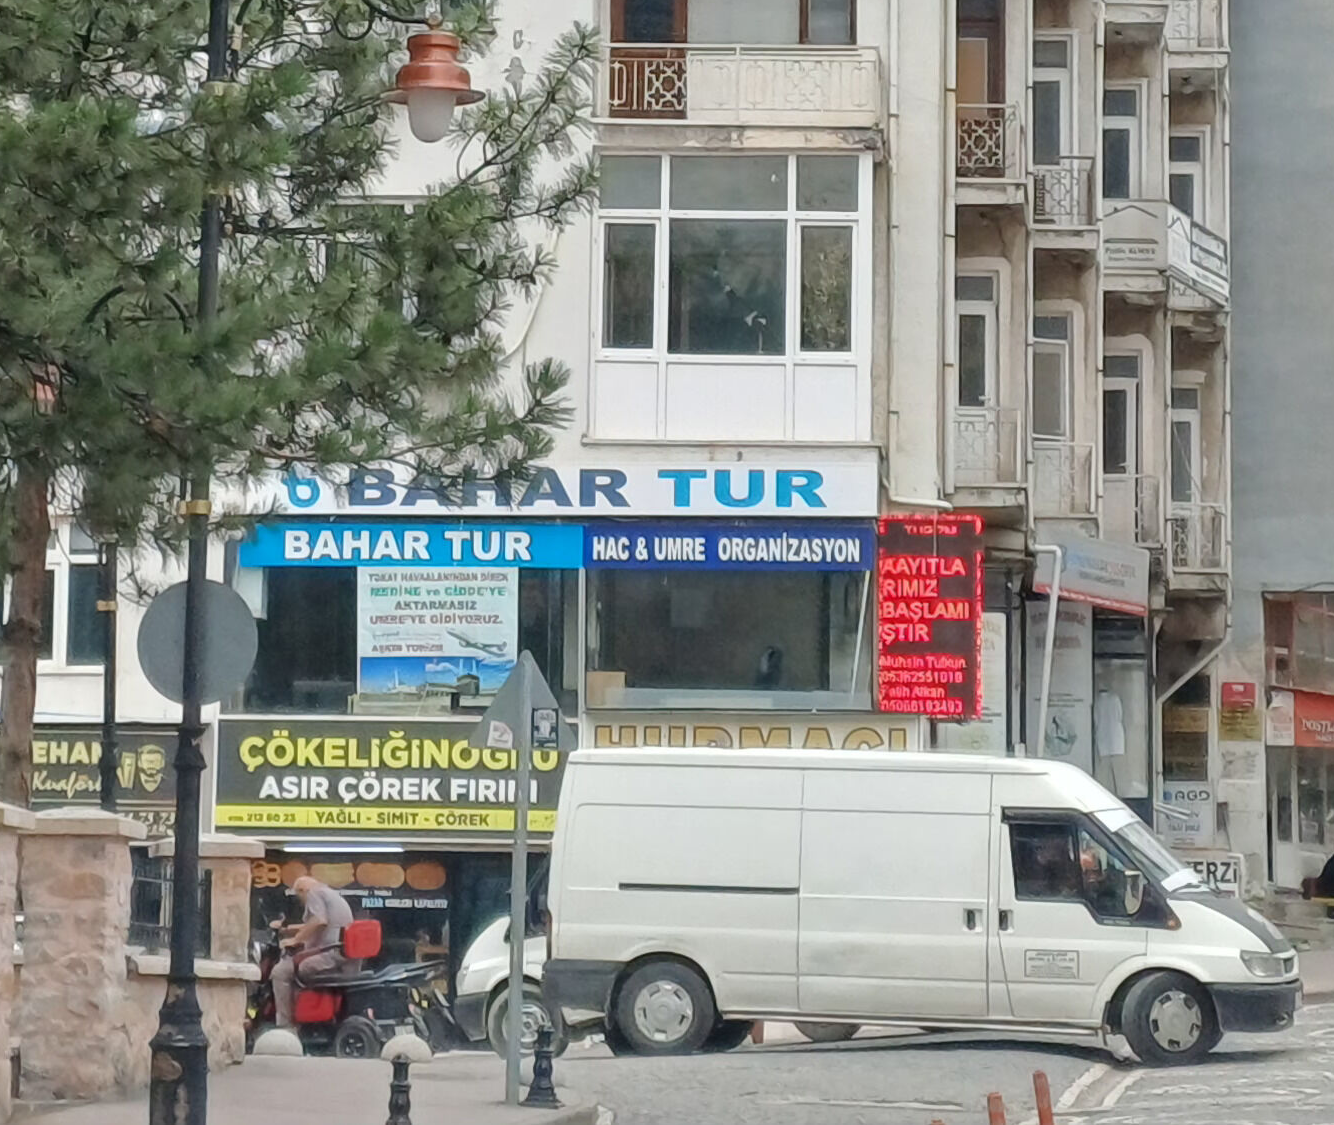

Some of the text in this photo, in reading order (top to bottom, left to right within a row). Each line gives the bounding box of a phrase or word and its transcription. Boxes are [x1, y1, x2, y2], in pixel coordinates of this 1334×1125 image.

[348, 467, 827, 508] BAHAR TUR
[284, 530, 531, 561] BAHAR TUR
[592, 532, 860, 563] HAC & UMRE ORGANİZASYON
[259, 776, 329, 800] ASIR
[338, 771, 444, 803] ÇÖREK
[315, 808, 361, 825] YAĞLI
[434, 810, 490, 827] ÇÖREK
[1185, 861, 1238, 885] ERZİ
